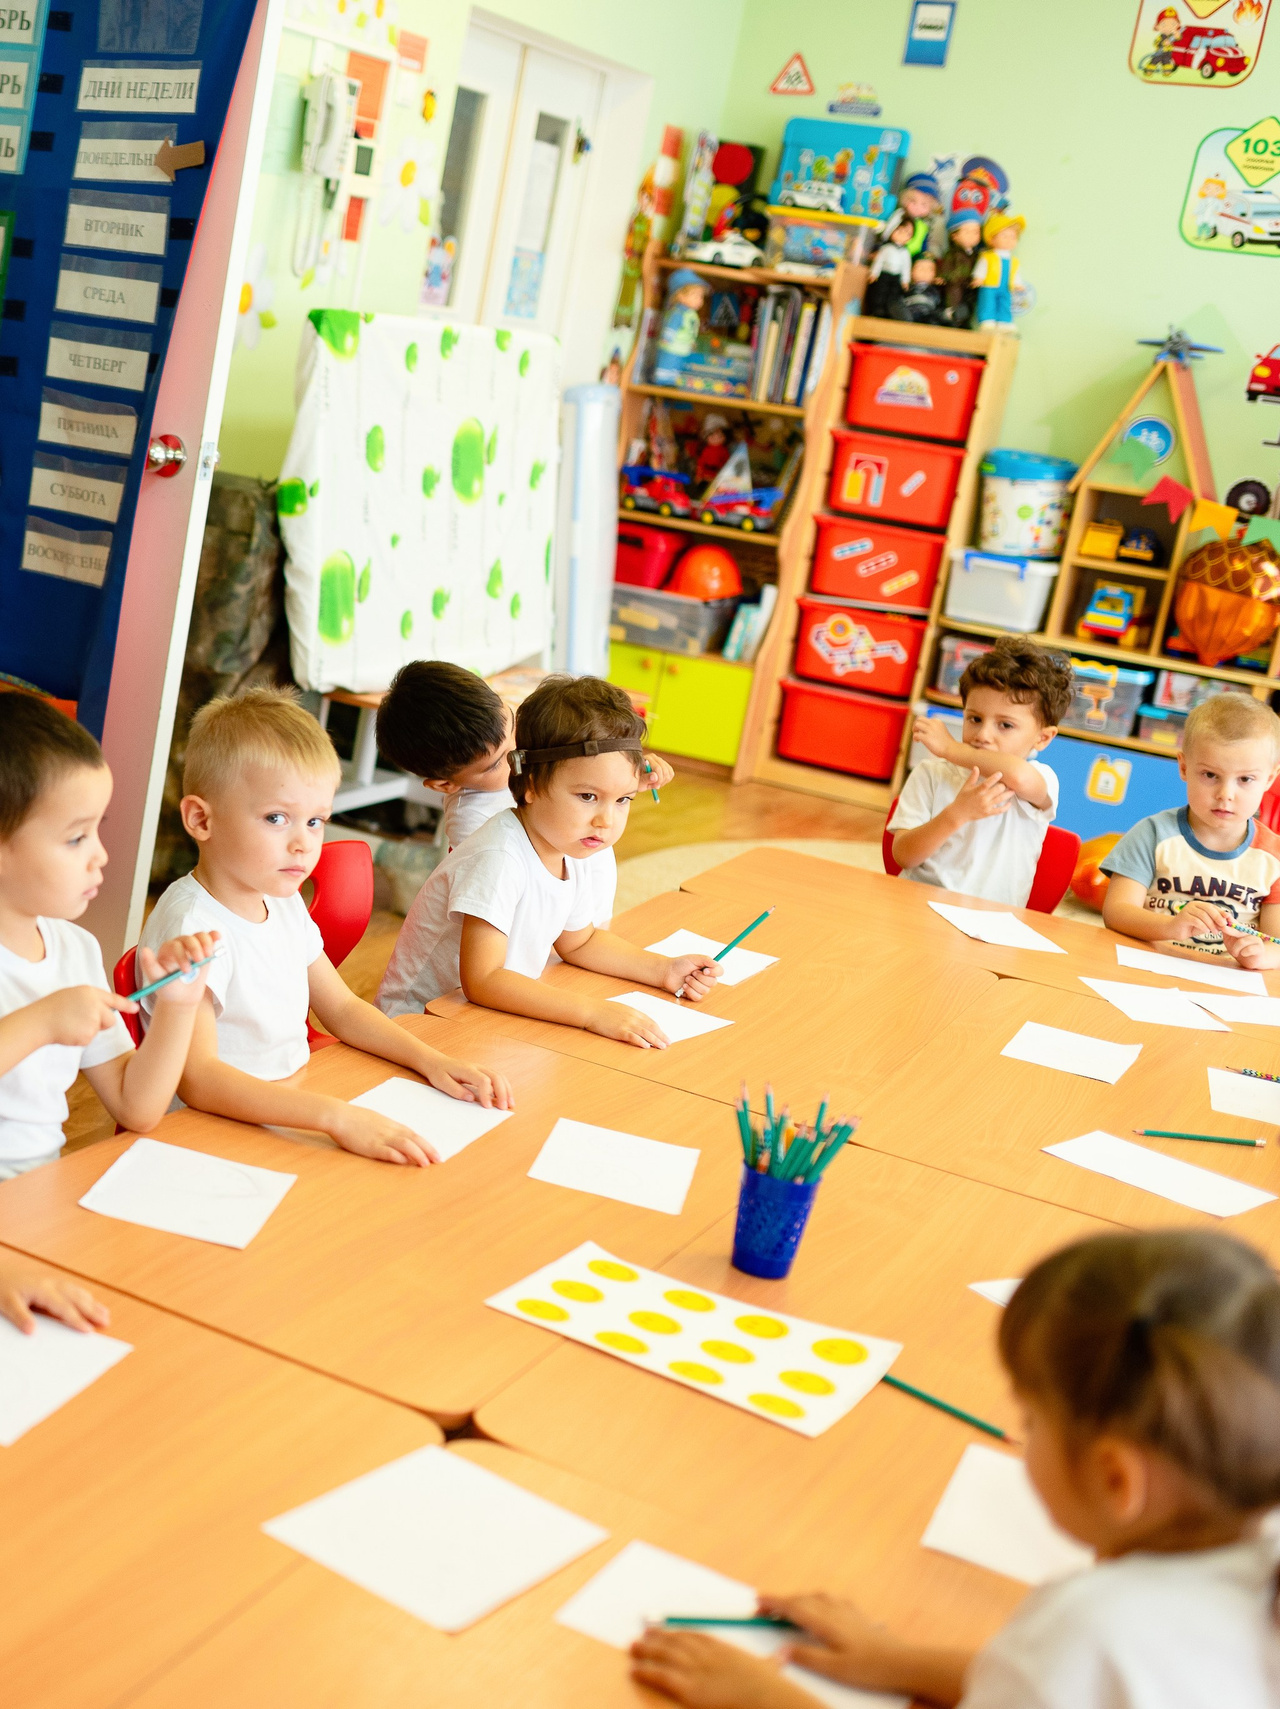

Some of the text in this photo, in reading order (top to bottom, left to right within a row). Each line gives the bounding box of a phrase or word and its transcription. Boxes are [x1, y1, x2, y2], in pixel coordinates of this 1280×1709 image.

[83, 80, 195, 102] ДНИ НЕДЕЛИ
[1243, 138, 1280, 157] 103
[76, 151, 158, 167] ПОНЕДЕЛЬН
[83, 218, 144, 238] ВТОРНИК
[82, 286, 126, 306] СРЕДА
[68, 353, 128, 375] ЧЕТВЕРГ
[56, 416, 120, 440] ПЯТНИЦА
[50, 481, 107, 507] СУББОТА
